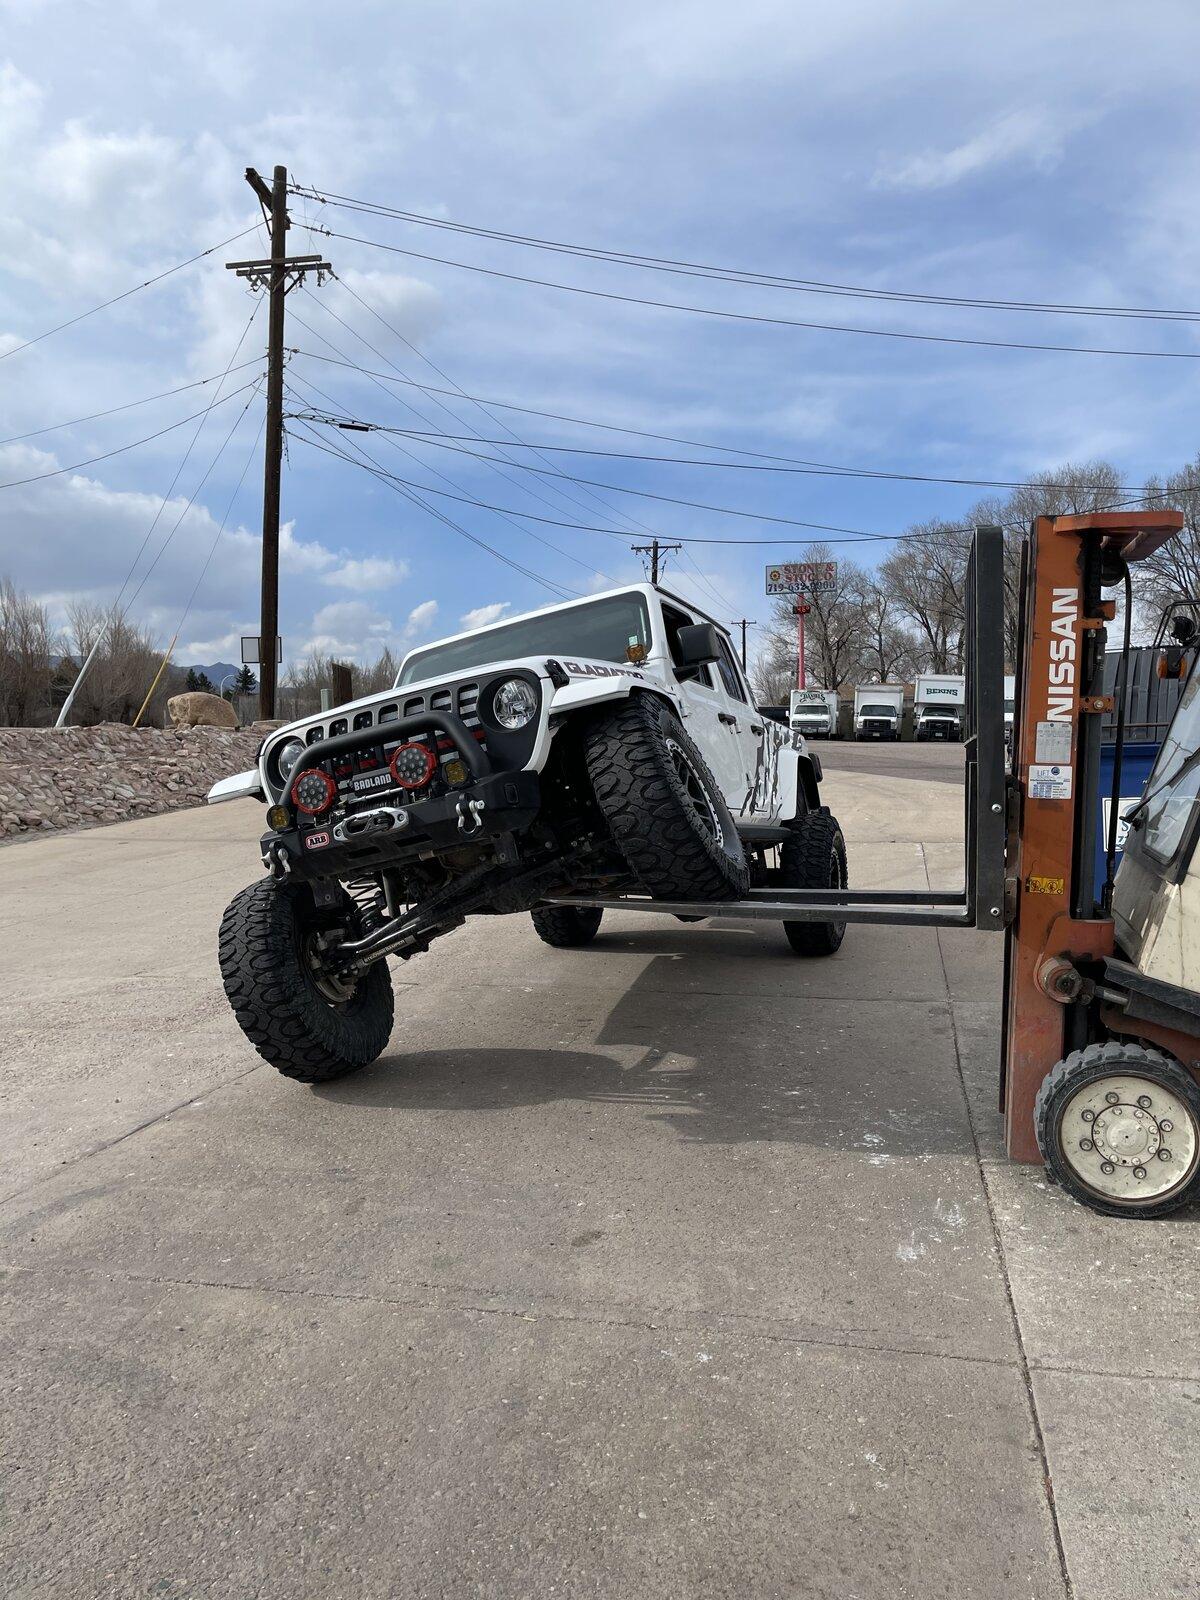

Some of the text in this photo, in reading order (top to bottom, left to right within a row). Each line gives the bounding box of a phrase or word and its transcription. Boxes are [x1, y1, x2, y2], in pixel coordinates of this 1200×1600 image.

[1046, 588, 1078, 722] NISSAN
[926, 688, 958, 696] BEKINS
[353, 773, 391, 791] BADLAND
[309, 835, 326, 846] ARB
